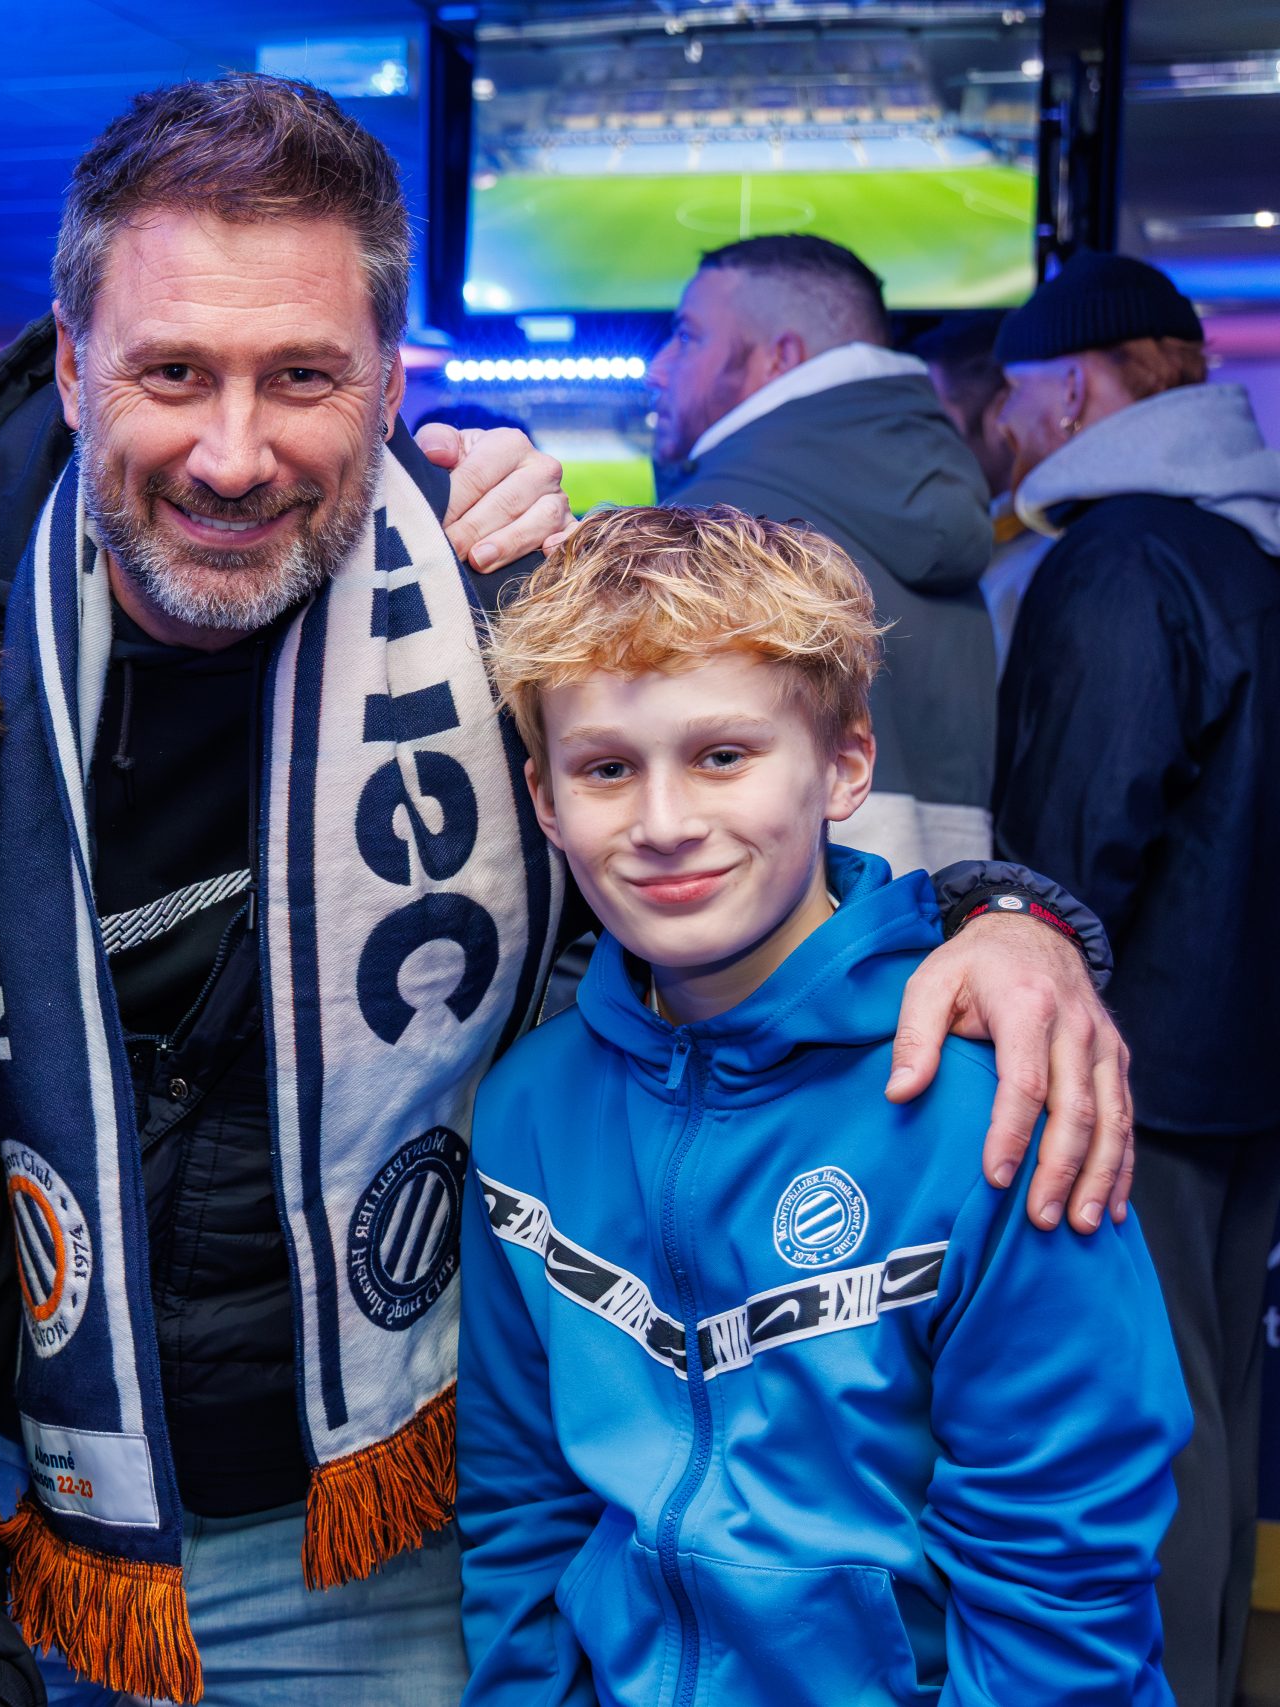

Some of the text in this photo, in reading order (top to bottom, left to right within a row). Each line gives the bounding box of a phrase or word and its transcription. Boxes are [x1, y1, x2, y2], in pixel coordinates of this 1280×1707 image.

[20, 1150, 53, 1192] Club
[776, 1169, 862, 1256] MONTPELLIER Hérault Sport Club
[68, 1223, 90, 1280] 1974
[791, 1249, 821, 1264] 1974
[594, 1277, 657, 1338] NIKE
[56, 1474, 94, 1499] 22-23
